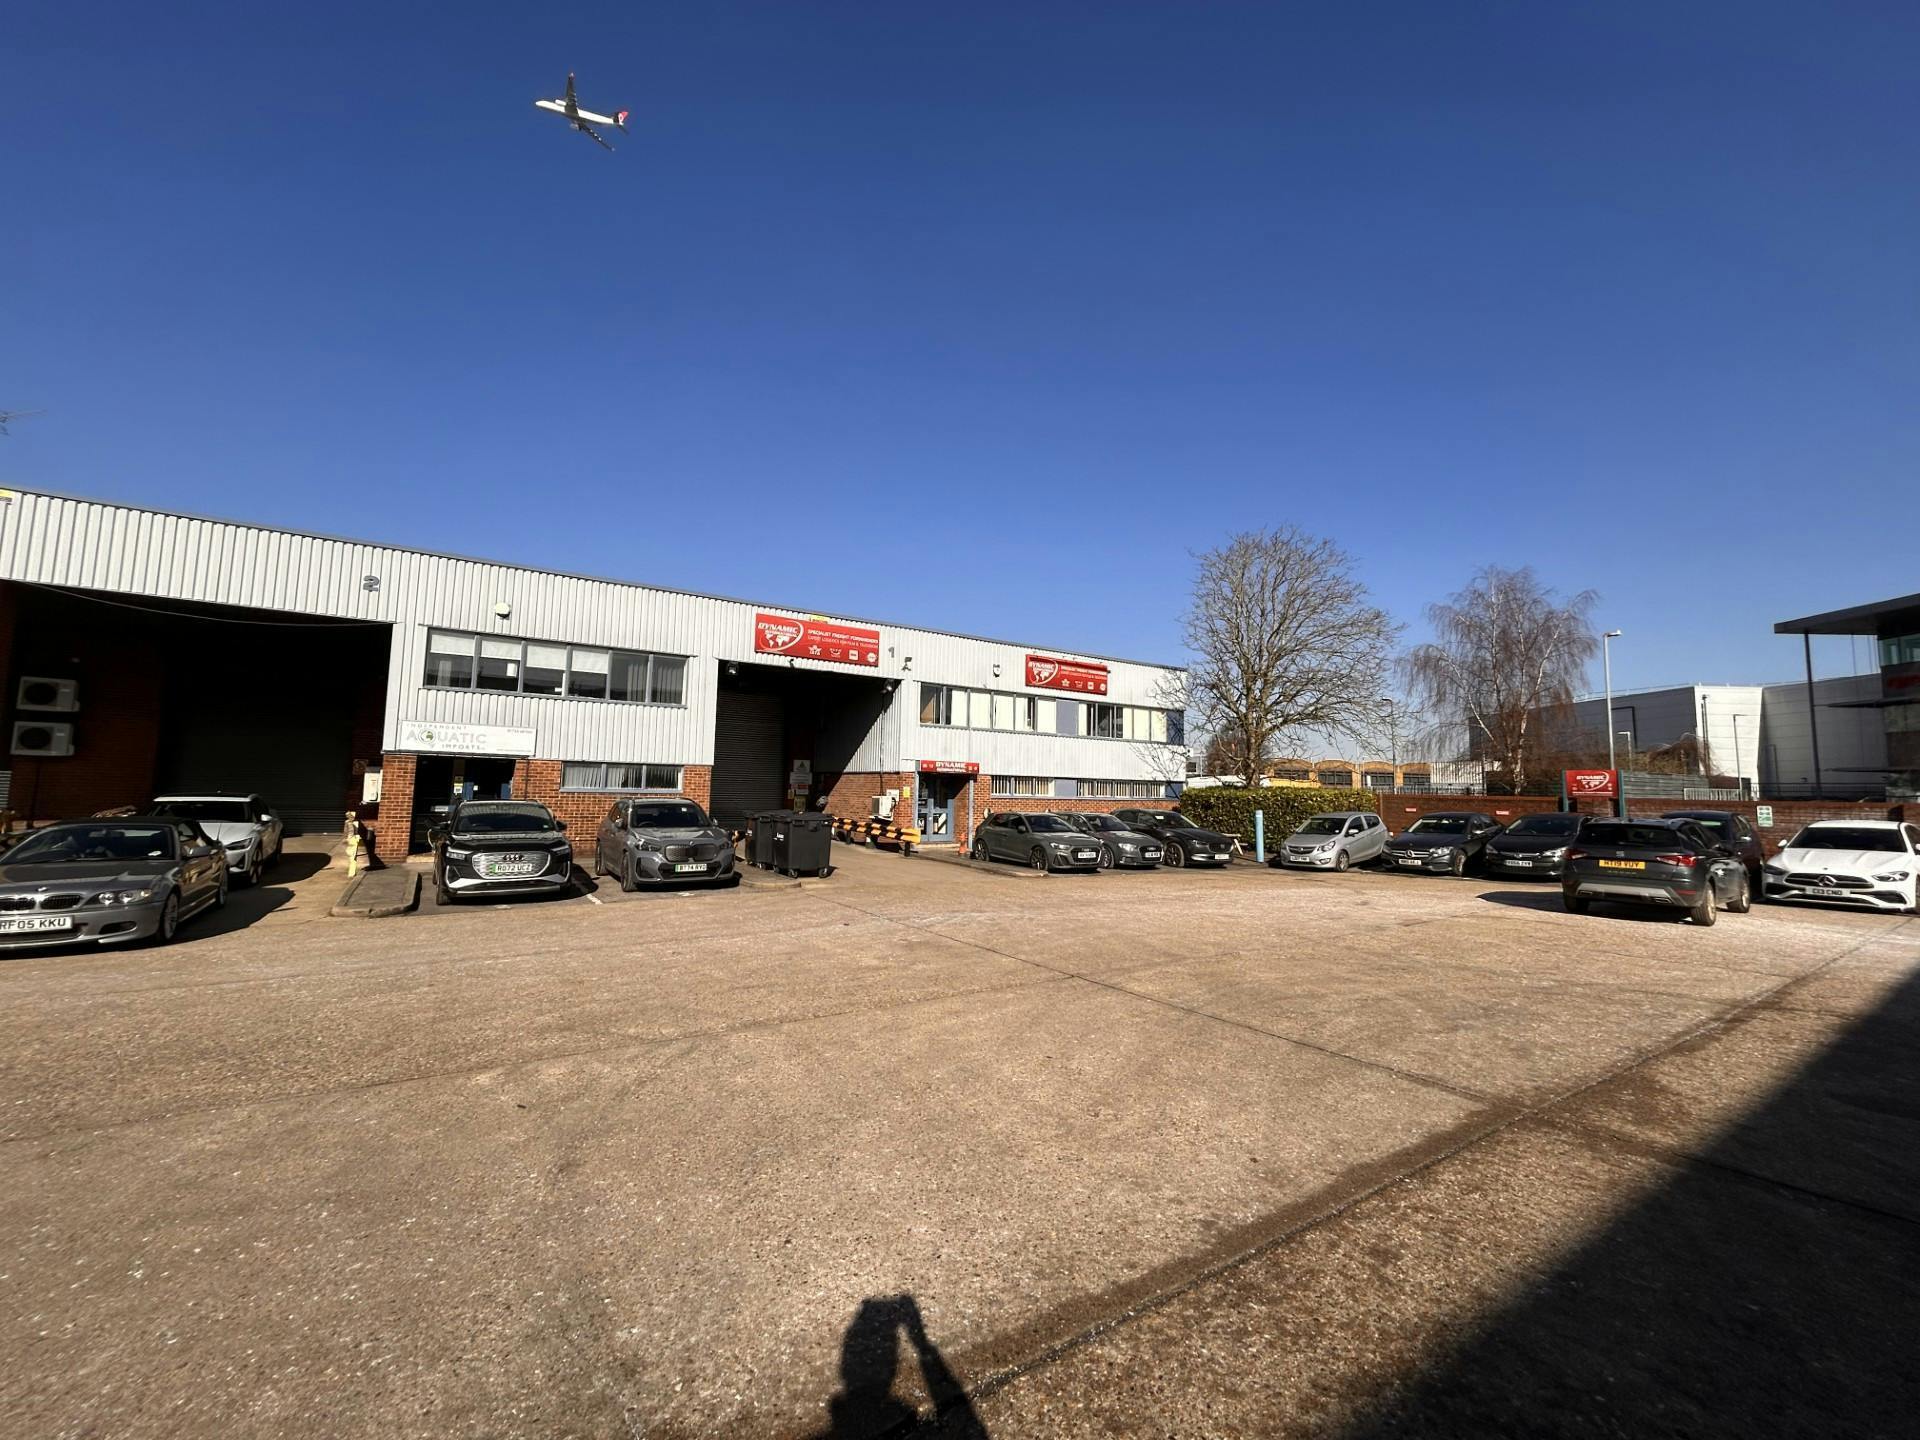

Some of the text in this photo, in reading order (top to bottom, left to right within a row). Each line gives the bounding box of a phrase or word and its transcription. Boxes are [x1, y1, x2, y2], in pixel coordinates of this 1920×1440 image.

[363, 575, 380, 592] 2
[758, 622, 799, 634] DYNAMIC
[807, 629, 832, 637] SPECIALIST
[441, 743, 480, 751] IMPORTS
[935, 761, 966, 769] DYNAMIC
[0, 918, 67, 930] RF05 KKU
